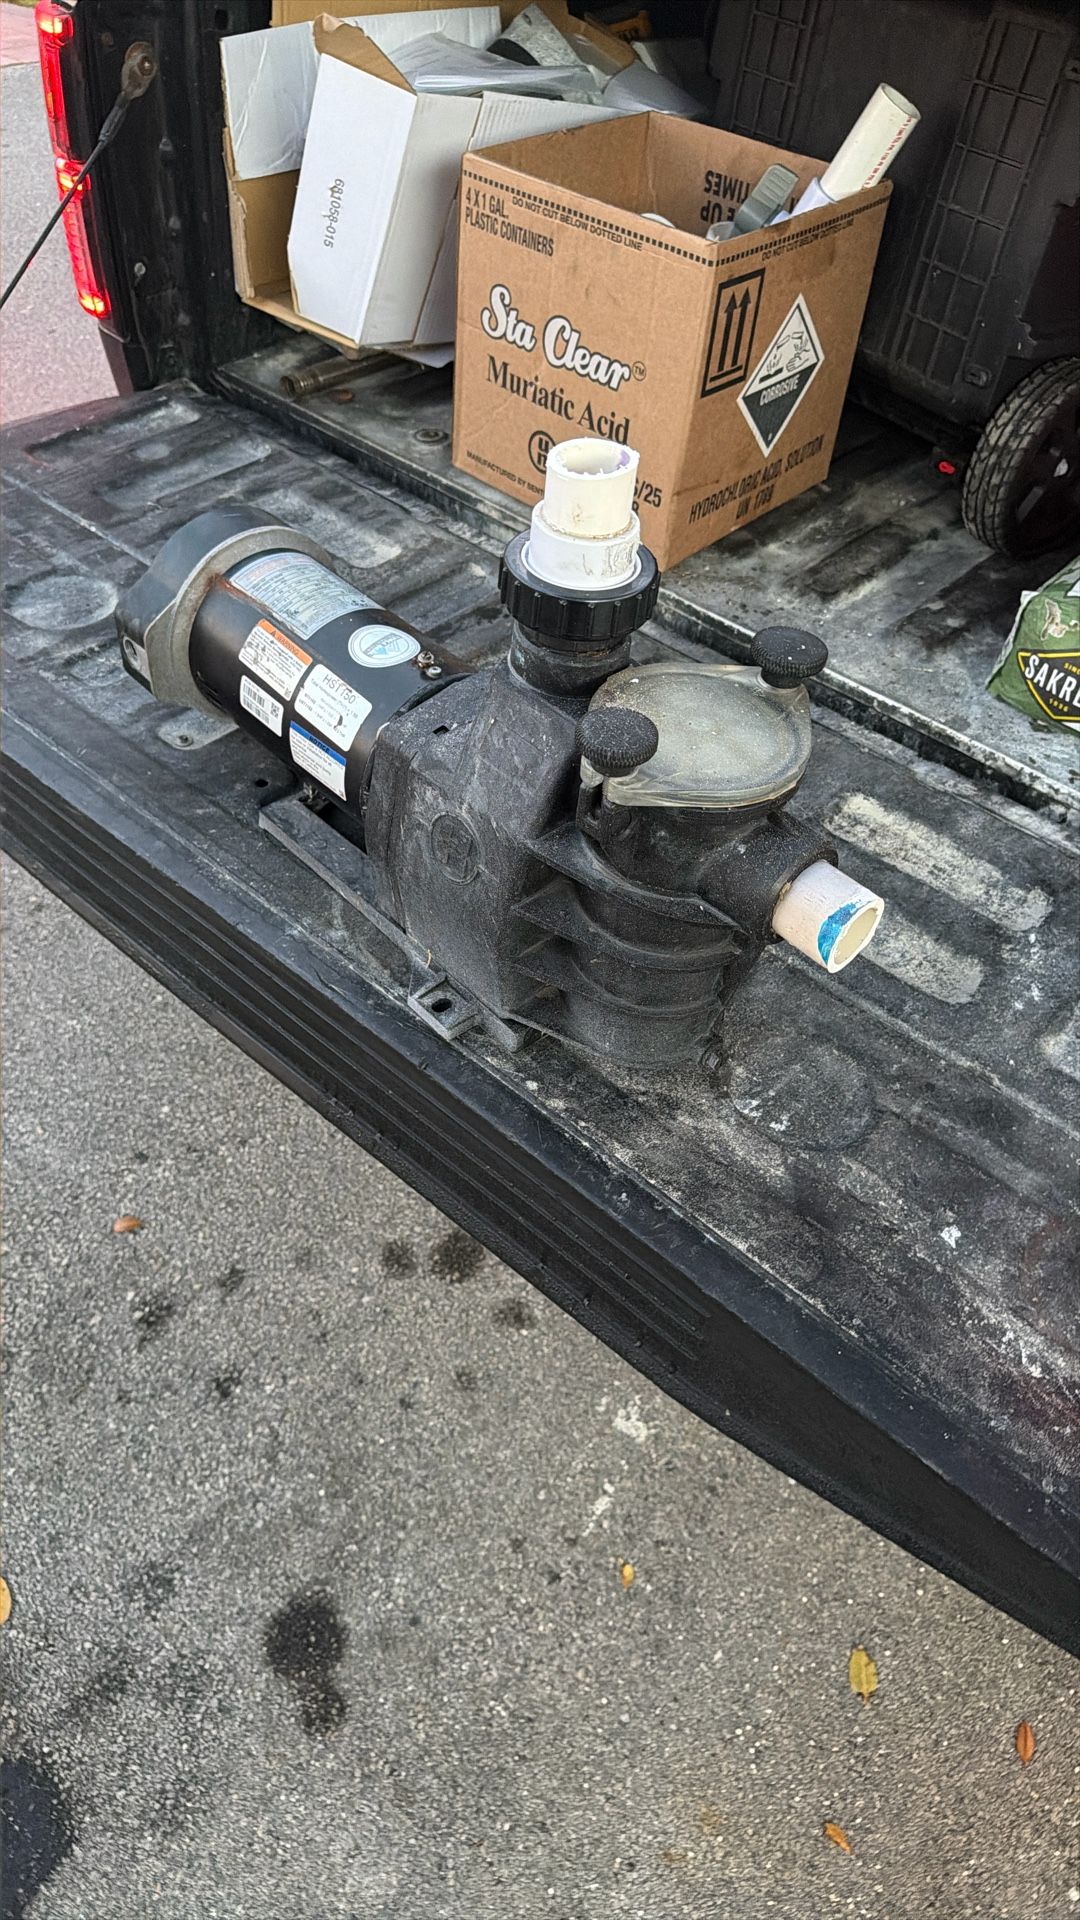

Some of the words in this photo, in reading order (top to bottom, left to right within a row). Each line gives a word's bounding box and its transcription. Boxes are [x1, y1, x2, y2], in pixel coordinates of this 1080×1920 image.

[466, 187, 471, 205] 4
[474, 189, 480, 208] X
[482, 193, 486, 210] 1
[489, 195, 509, 219] GAL.
[512, 196, 523, 208] DO
[525, 201, 541, 214] NOT
[542, 207, 559, 220] CUT
[560, 213, 588, 231] BELOW
[590, 224, 622, 244] DOTTED
[624, 236, 643, 252] LINE
[701, 200, 722, 224] UP
[466, 206, 499, 235] PLASTIC
[500, 220, 554, 257] CONTAINERS
[480, 284, 537, 352] Sta
[543, 315, 631, 392] Clear
[486, 353, 575, 421] Muriatic
[577, 401, 630, 446] Acid
[760, 374, 800, 406] CORROSIVE
[466, 450, 516, 482] MANUFACTURED
[518, 477, 525, 487] BY
[689, 470, 761, 524] HYDROCHLORIC
[309, 736, 330, 752] NOTICE
